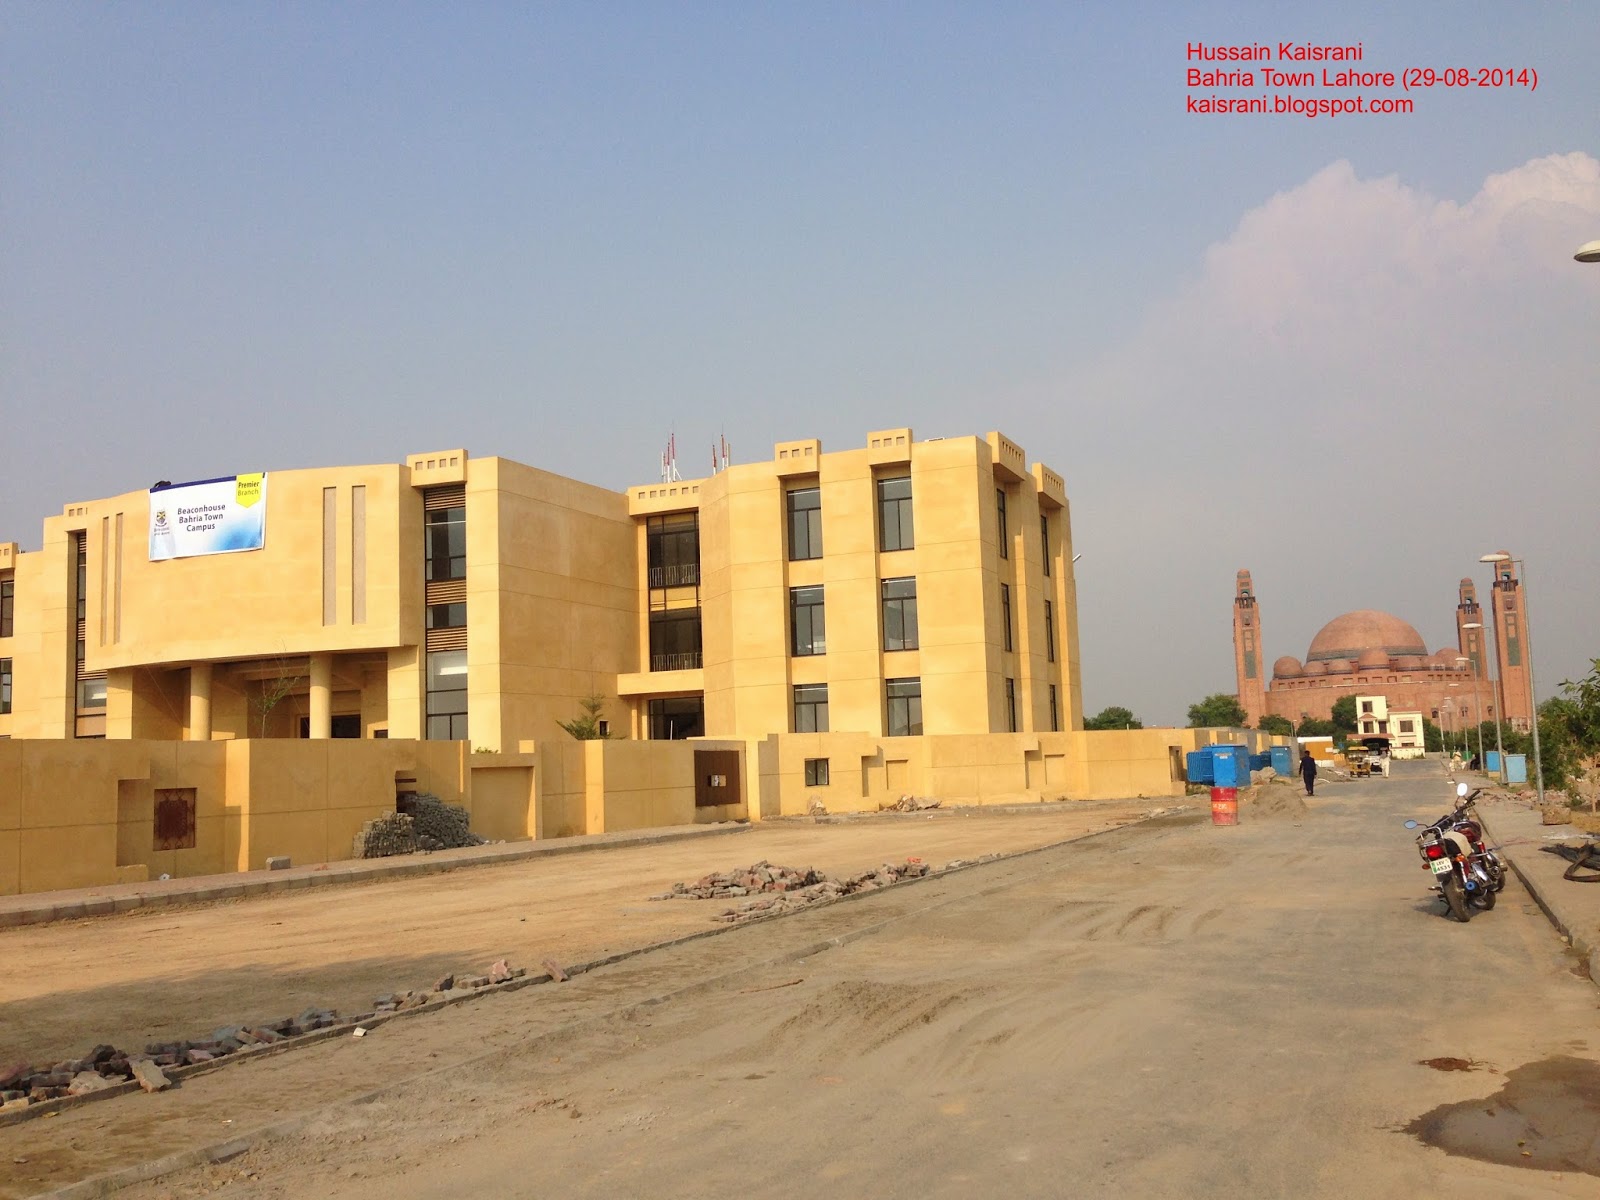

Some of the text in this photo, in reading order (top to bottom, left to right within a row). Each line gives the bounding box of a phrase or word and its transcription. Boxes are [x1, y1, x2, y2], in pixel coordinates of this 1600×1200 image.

[238, 480, 260, 489] Premier
[237, 488, 259, 497] Branch
[177, 504, 226, 515] Beaconhouse
[179, 513, 224, 524] Bahria Town
[186, 523, 216, 532] Campus
